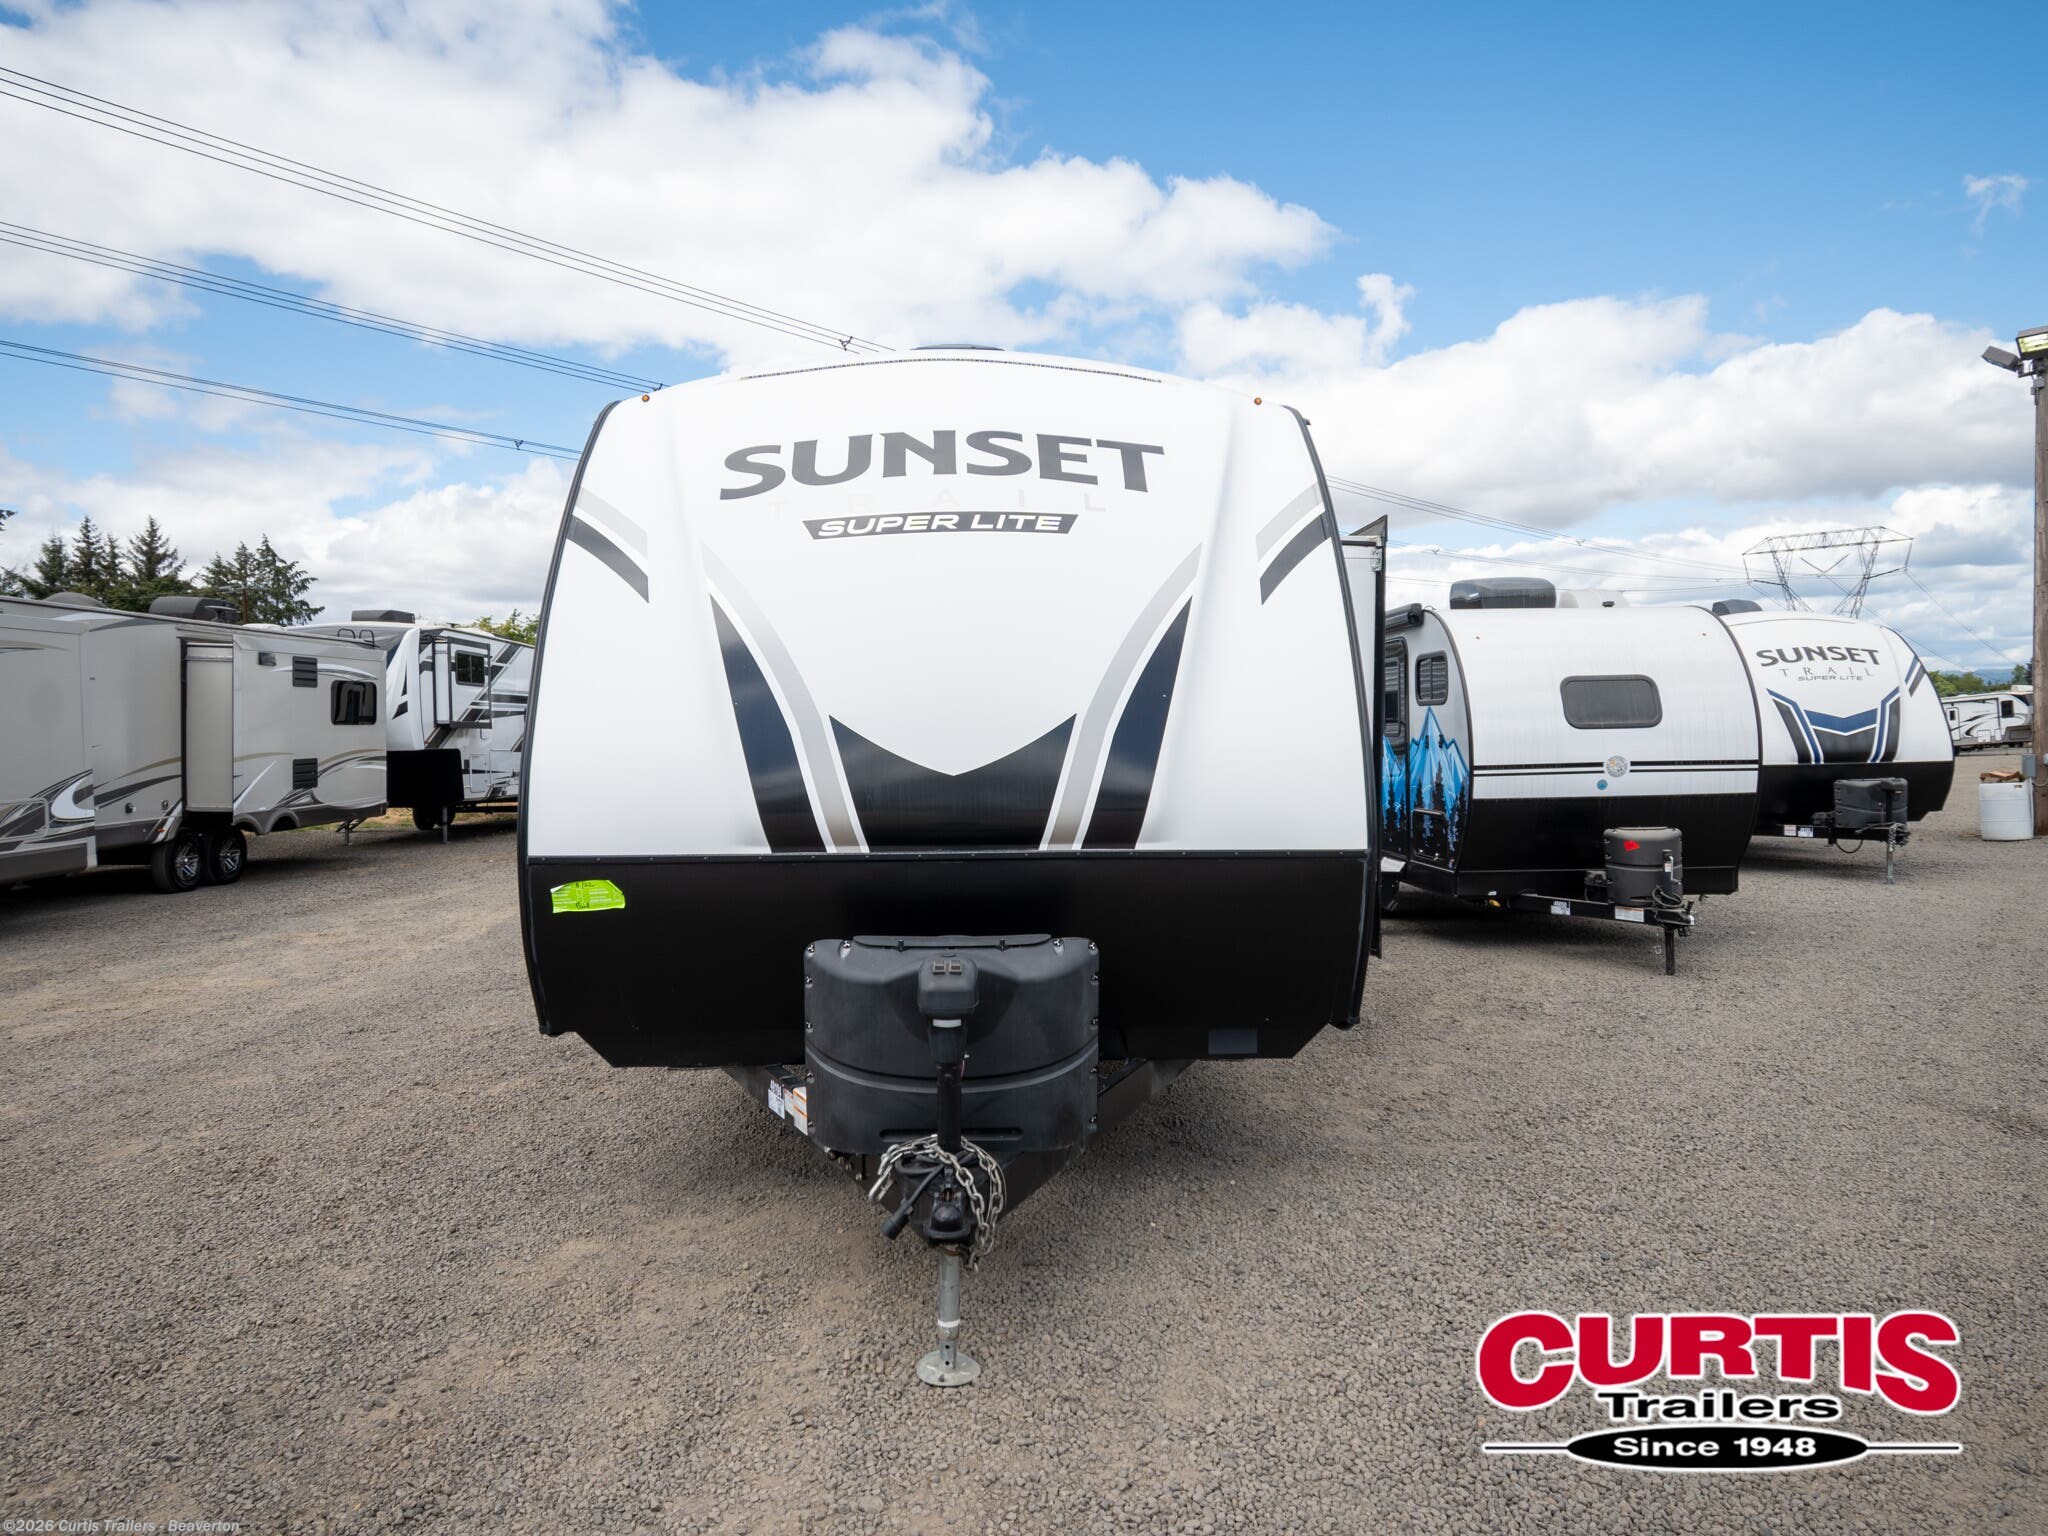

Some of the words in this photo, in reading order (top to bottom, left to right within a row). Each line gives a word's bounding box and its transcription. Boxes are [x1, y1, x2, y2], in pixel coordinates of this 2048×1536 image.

[720, 430, 1165, 500] SUNSET
[817, 513, 960, 537] SUPER
[971, 513, 1063, 532] LITE
[1756, 646, 1880, 667] SUNSET
[1779, 666, 1875, 677] TRAIL
